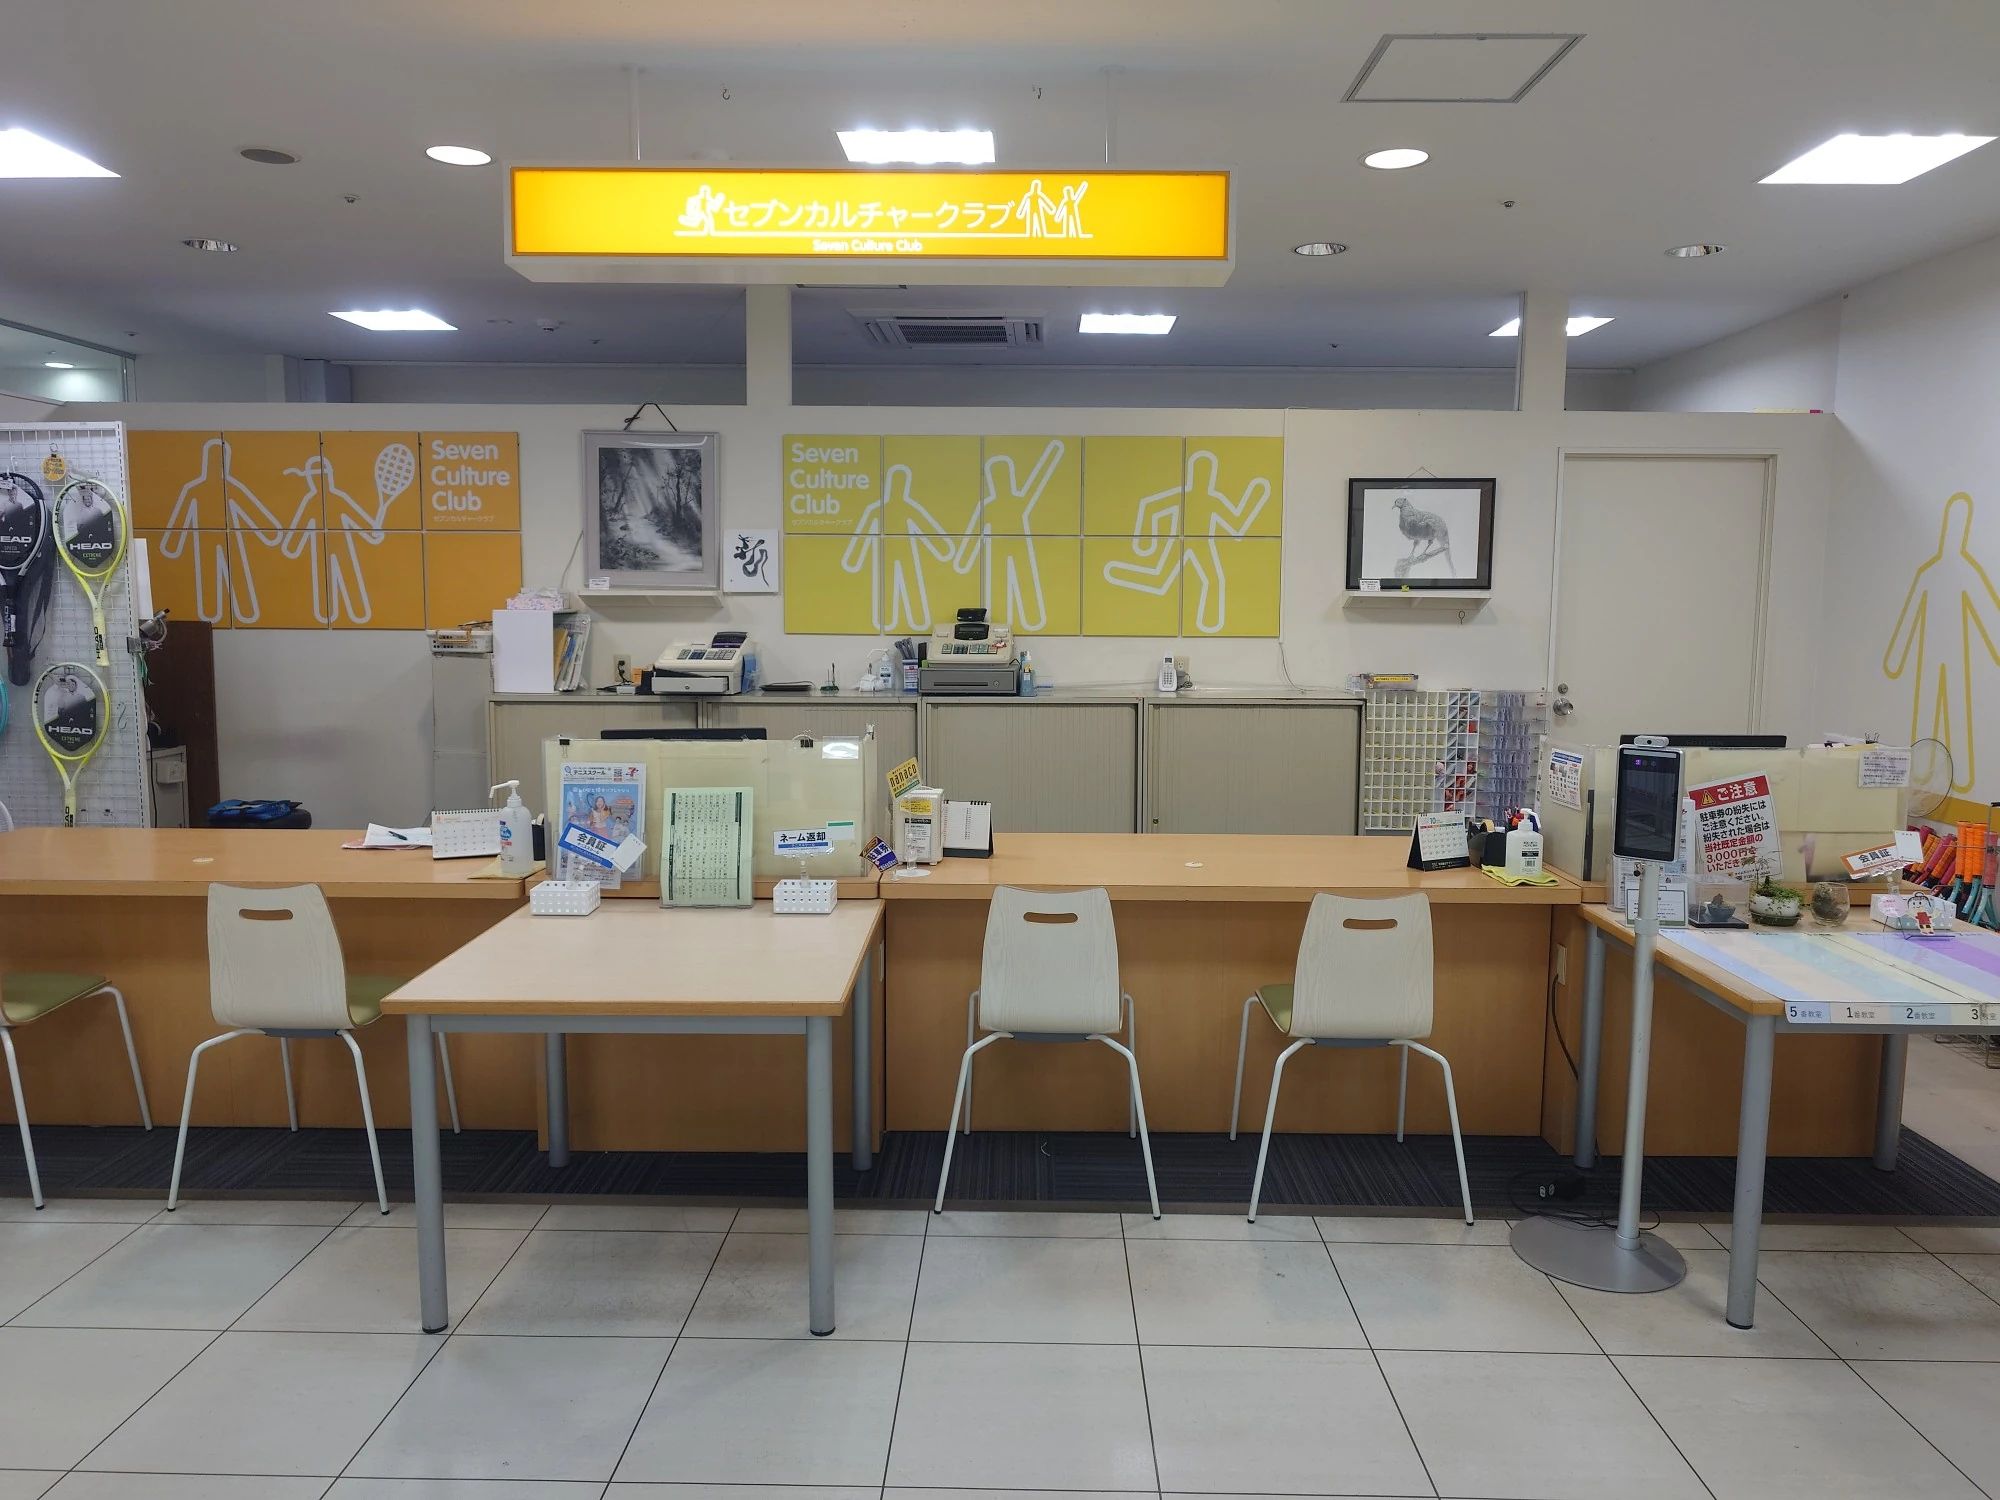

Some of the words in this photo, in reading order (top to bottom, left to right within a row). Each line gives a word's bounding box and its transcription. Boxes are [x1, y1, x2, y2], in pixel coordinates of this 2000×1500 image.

[724, 199, 1016, 229] セブンカルチャークラブ
[813, 238, 849, 252] Seven
[851, 238, 893, 252] Culture
[896, 238, 923, 252] Club
[431, 439, 498, 460] Seven
[791, 443, 858, 463] Seven
[431, 465, 510, 487] Culture
[790, 468, 869, 490] Culture
[431, 490, 482, 511] Club
[790, 493, 840, 515] Club
[69, 542, 112, 550] HEAD
[48, 725, 93, 735] HEAD
[889, 763, 918, 788] nanaco
[1717, 781, 1758, 801] ご注意
[1699, 800, 1767, 822] 駐車券の紛失には
[1701, 812, 1765, 832] ご注意ください。
[1703, 821, 1770, 842] 紛失された場合は
[577, 832, 608, 852] 会員証
[780, 831, 826, 843] ネーム返却
[1704, 834, 1763, 853] 当社既定金額の
[867, 842, 890, 862] 駐車券
[1858, 848, 1892, 864] 会員証
